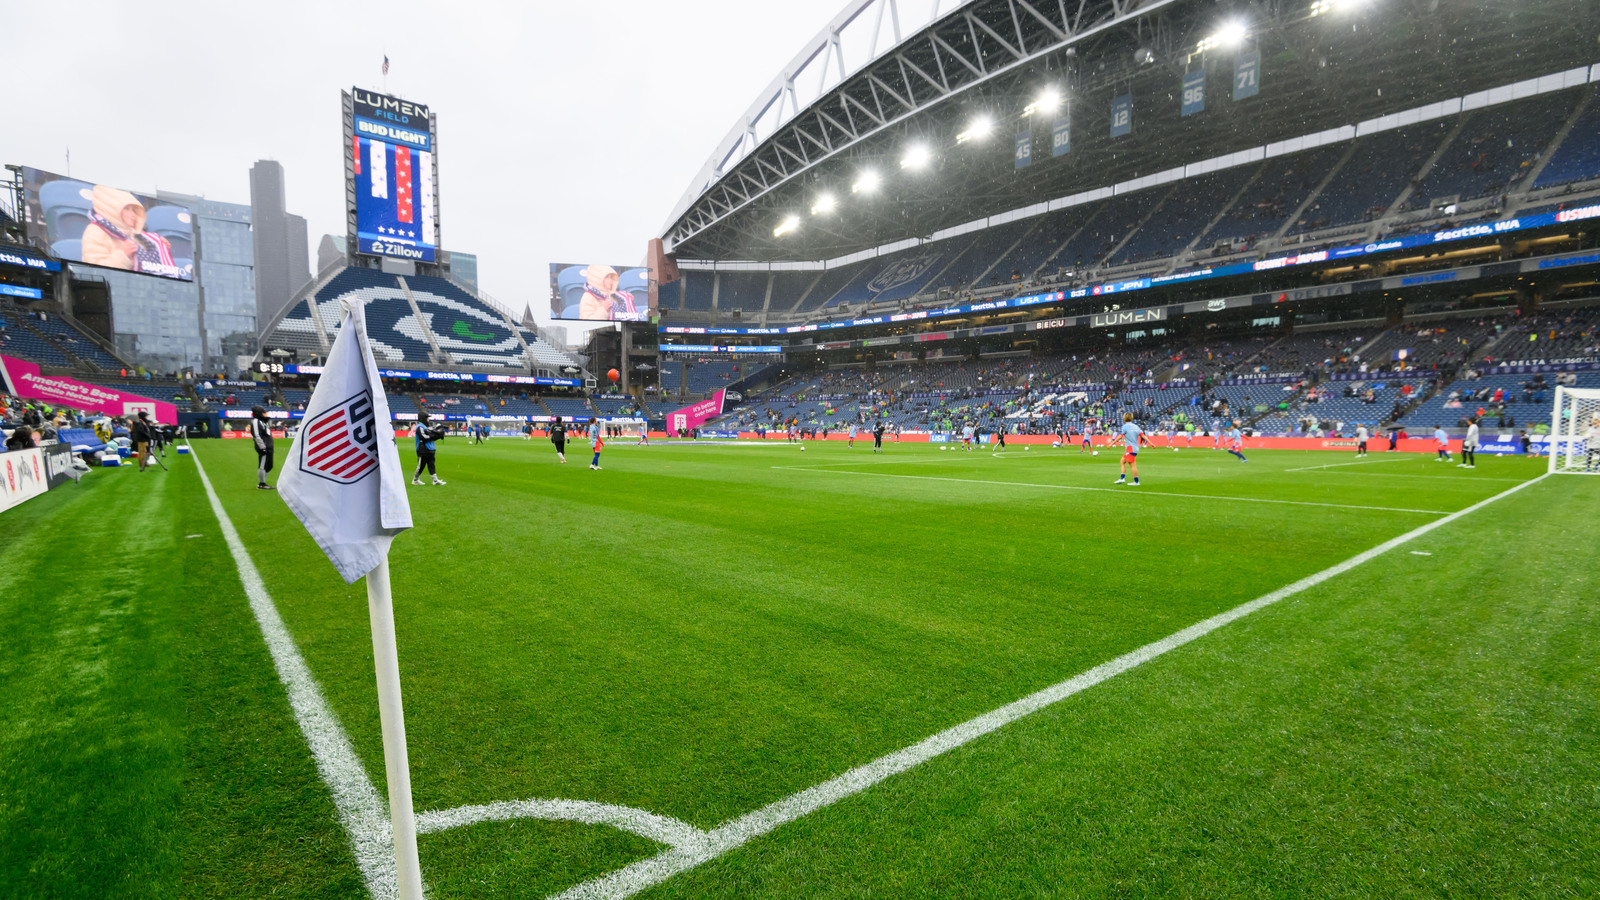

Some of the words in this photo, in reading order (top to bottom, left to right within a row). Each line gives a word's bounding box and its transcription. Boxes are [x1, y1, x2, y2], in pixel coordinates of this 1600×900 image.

[1238, 70, 1255, 89] 71
[1184, 86, 1203, 106] 96
[354, 90, 429, 119] LUMEN
[376, 109, 409, 124] FIELD
[1114, 110, 1128, 127] 12
[358, 120, 388, 136] BUD
[389, 127, 427, 146] LIGHT
[1054, 131, 1069, 148] 80
[1016, 144, 1030, 160] 45
[1433, 225, 1493, 242] Seattle,
[1494, 219, 1521, 232] WA
[385, 243, 424, 259] Zillow
[27, 258, 47, 268] WA
[1120, 281, 1143, 291] JPN
[1294, 285, 1344, 300] DELTA
[971, 303, 996, 311] Seattle,
[1020, 296, 1039, 304] USA
[1208, 299, 1226, 307] aws
[1036, 320, 1065, 330] BECU
[1095, 309, 1161, 326] LUMEN
[260, 362, 284, 373] 8:33
[21, 372, 90, 395] America's
[90, 388, 120, 402] Best
[32, 383, 65, 396] Mobile
[65, 391, 105, 405] Network
